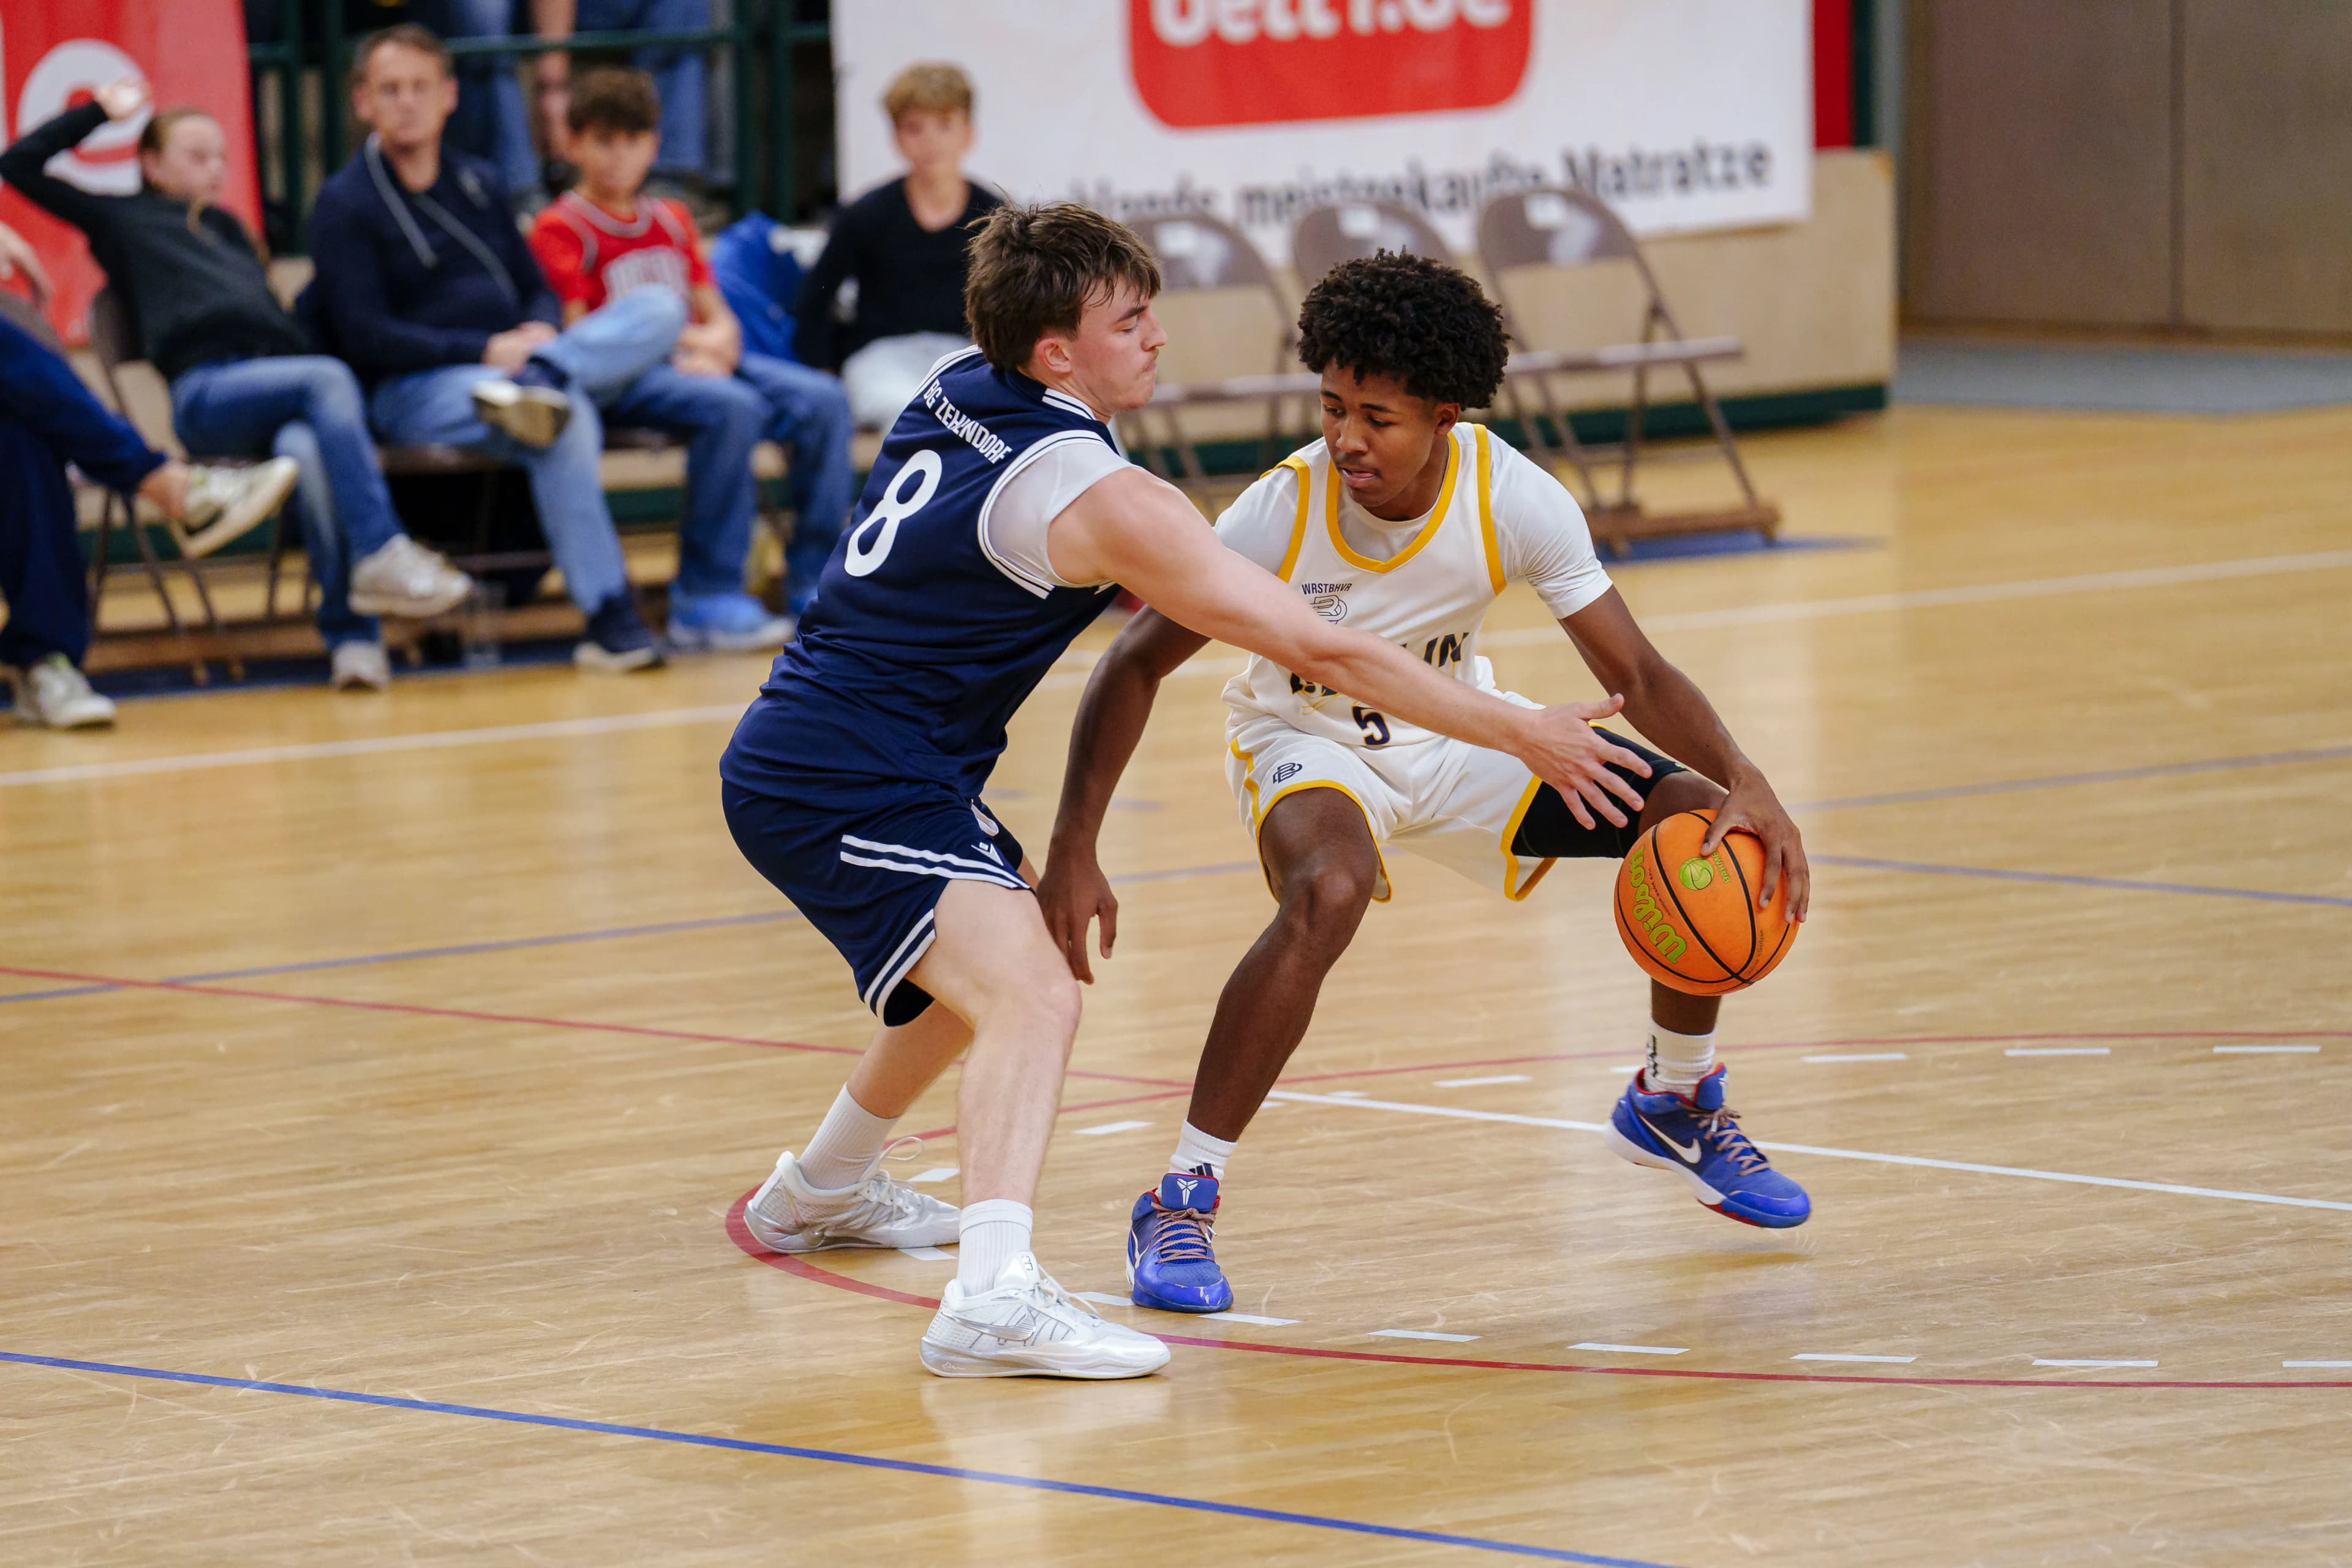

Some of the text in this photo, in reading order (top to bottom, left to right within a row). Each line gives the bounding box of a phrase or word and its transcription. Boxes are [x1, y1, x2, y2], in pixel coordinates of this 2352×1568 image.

[1561, 137, 1771, 201] Matratze
[924, 379, 942, 409] BG
[844, 449, 943, 577] 8
[1302, 582, 1352, 595] WRSTBHVR
[1352, 706, 1390, 746] 5
[1629, 845, 1687, 965] Wilson
